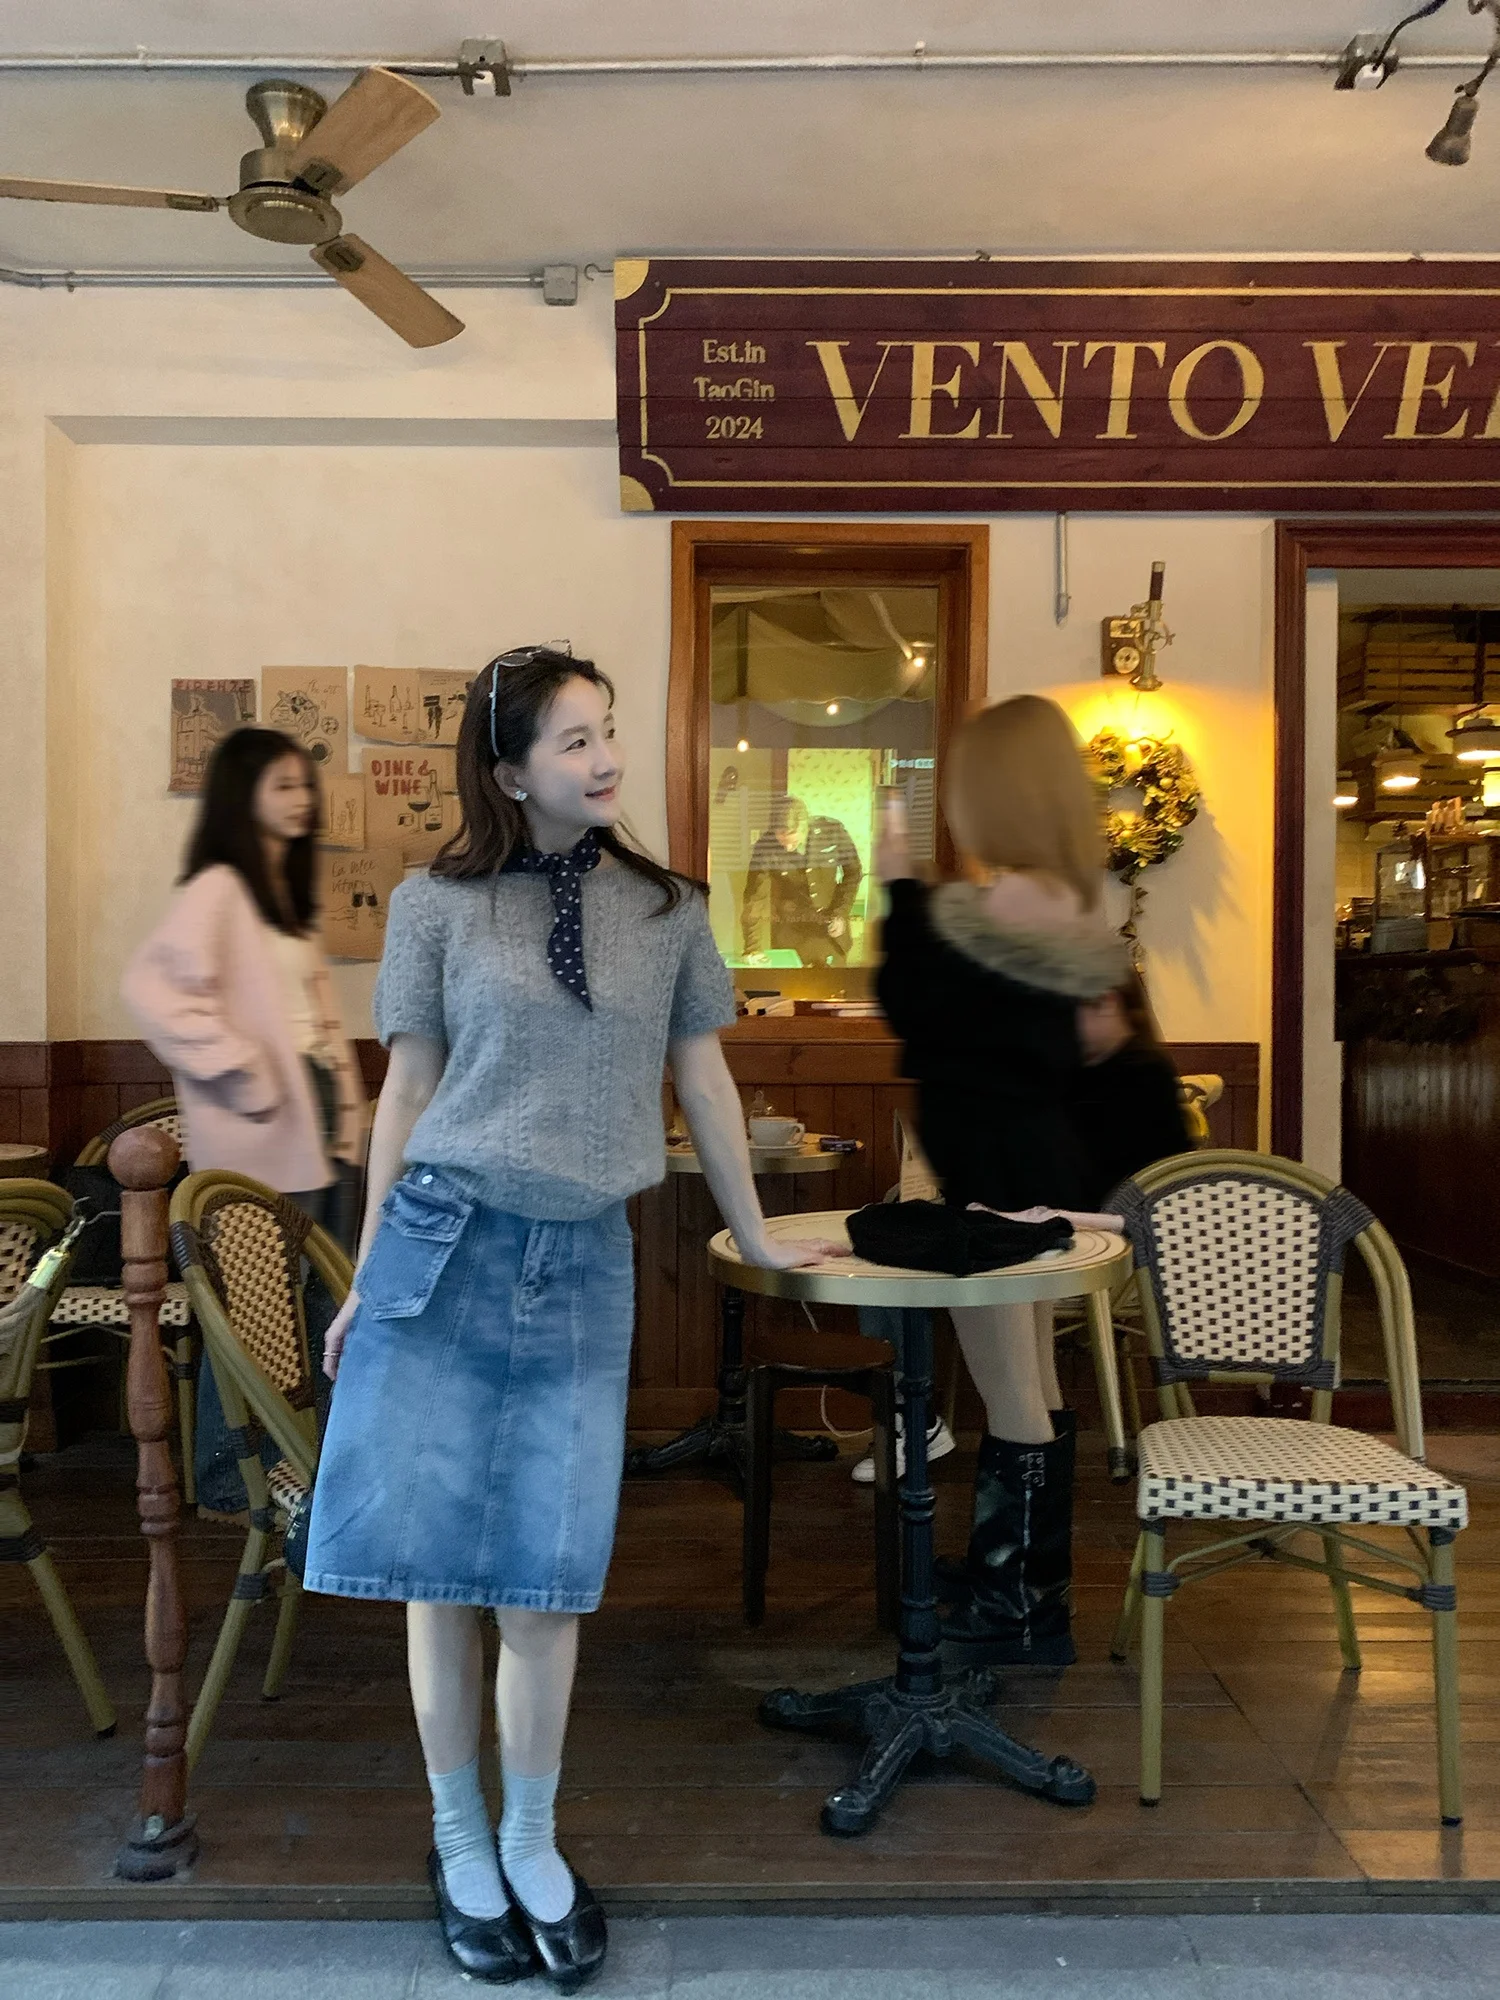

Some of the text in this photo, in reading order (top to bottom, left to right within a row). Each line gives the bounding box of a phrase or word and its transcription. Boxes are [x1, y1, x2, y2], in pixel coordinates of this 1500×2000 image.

[703, 339, 766, 363] Est.in
[805, 339, 1500, 442] VENTO VE
[705, 415, 764, 439] 2024
[371, 759, 430, 777] DINE &
[375, 779, 421, 796] WINE
